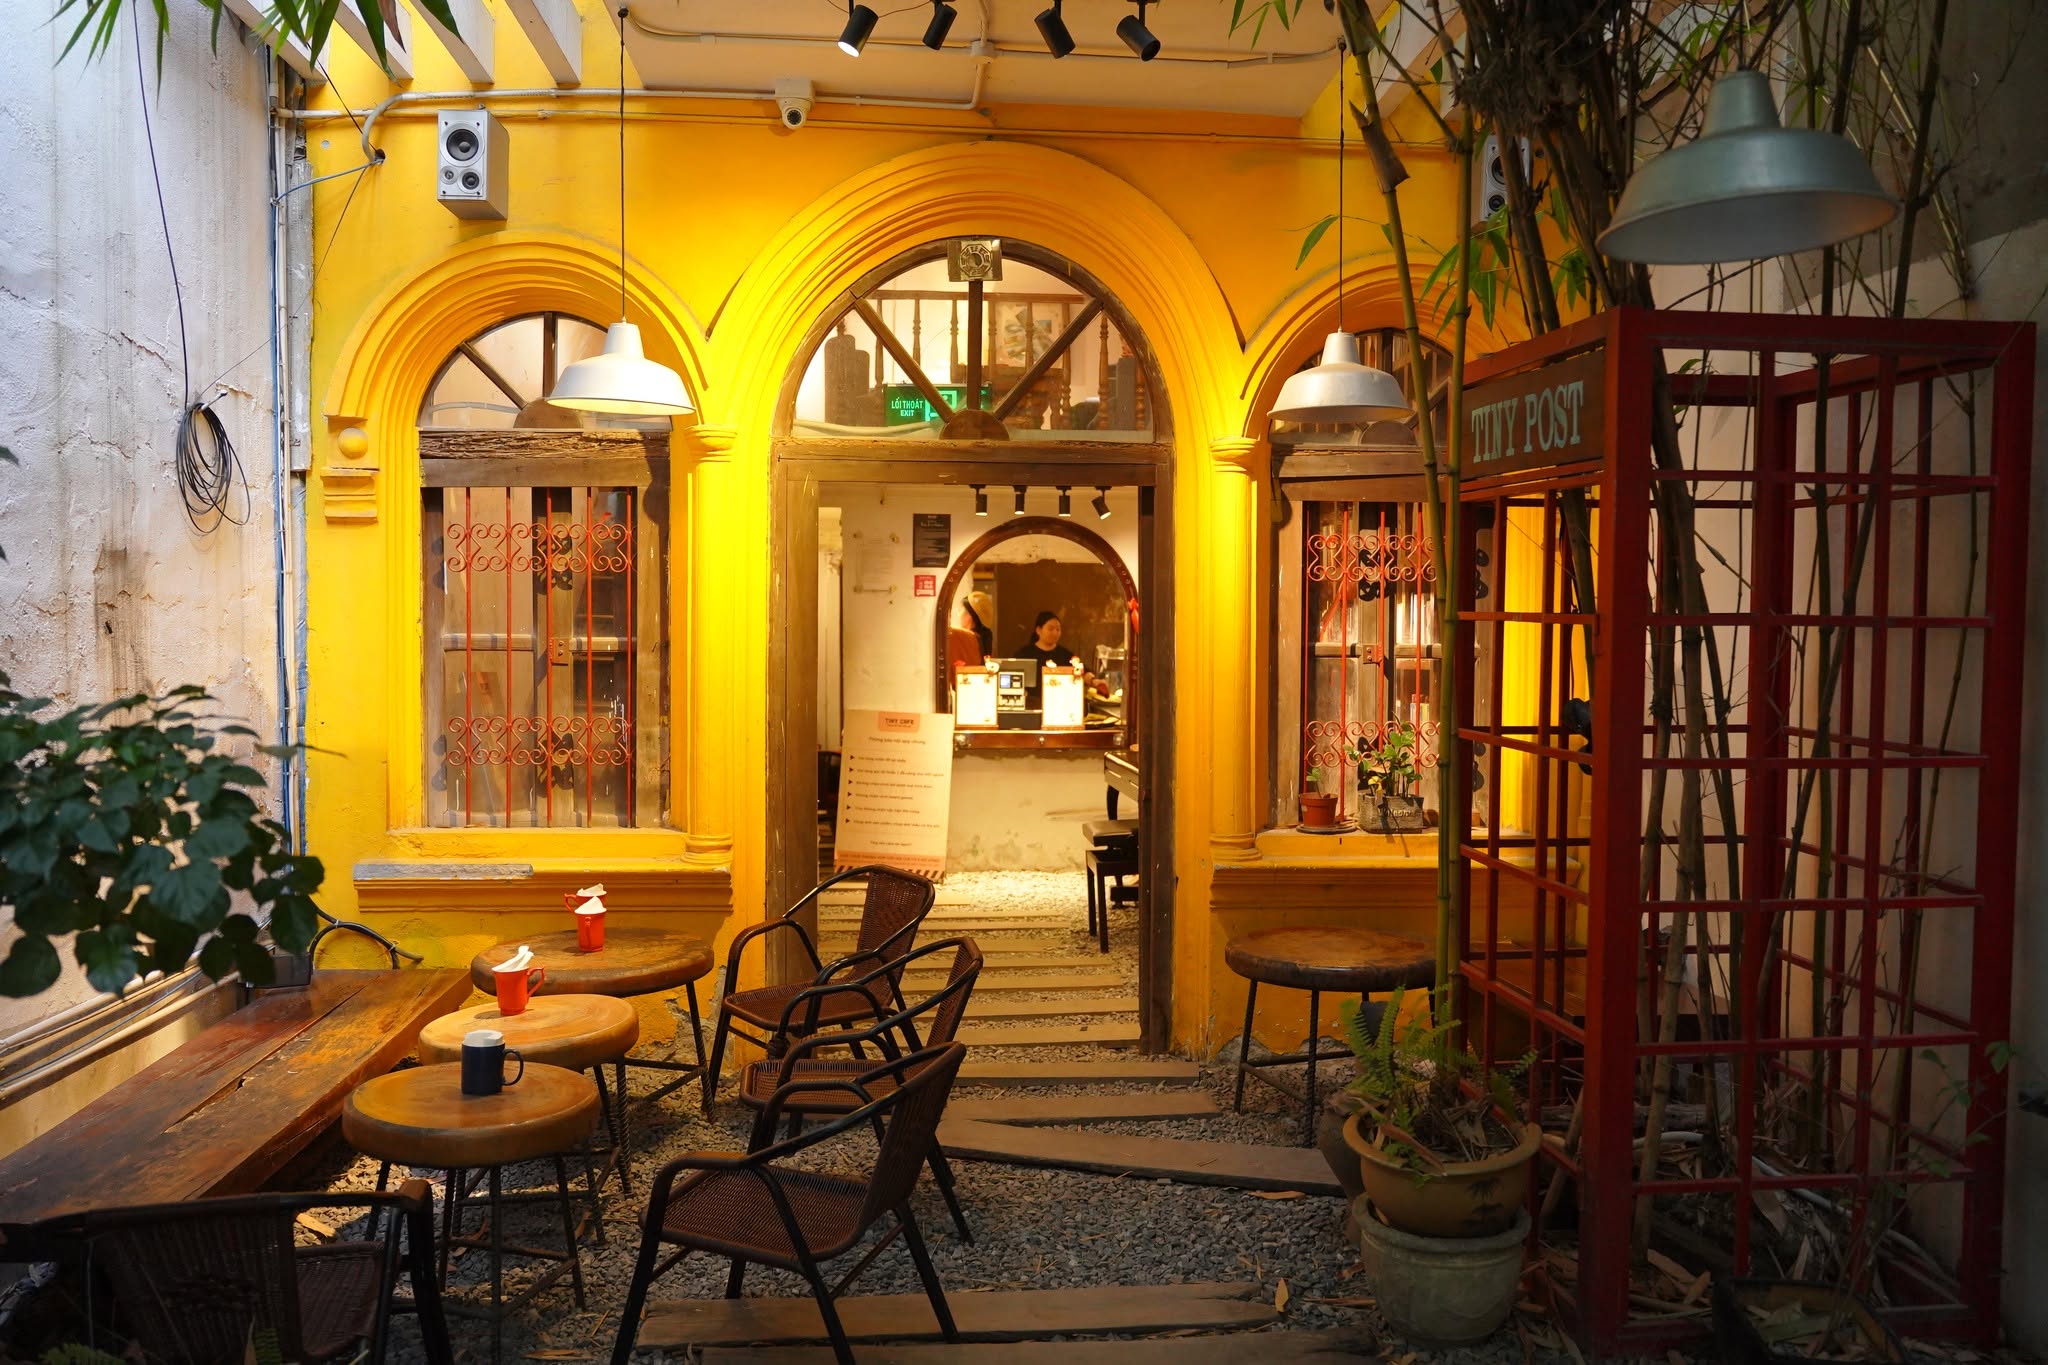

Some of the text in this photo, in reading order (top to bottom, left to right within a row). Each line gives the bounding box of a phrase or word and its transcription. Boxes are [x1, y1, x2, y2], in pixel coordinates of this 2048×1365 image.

[891, 397, 923, 408] LỐI THOÁT
[1471, 380, 1584, 464] TINY POST
